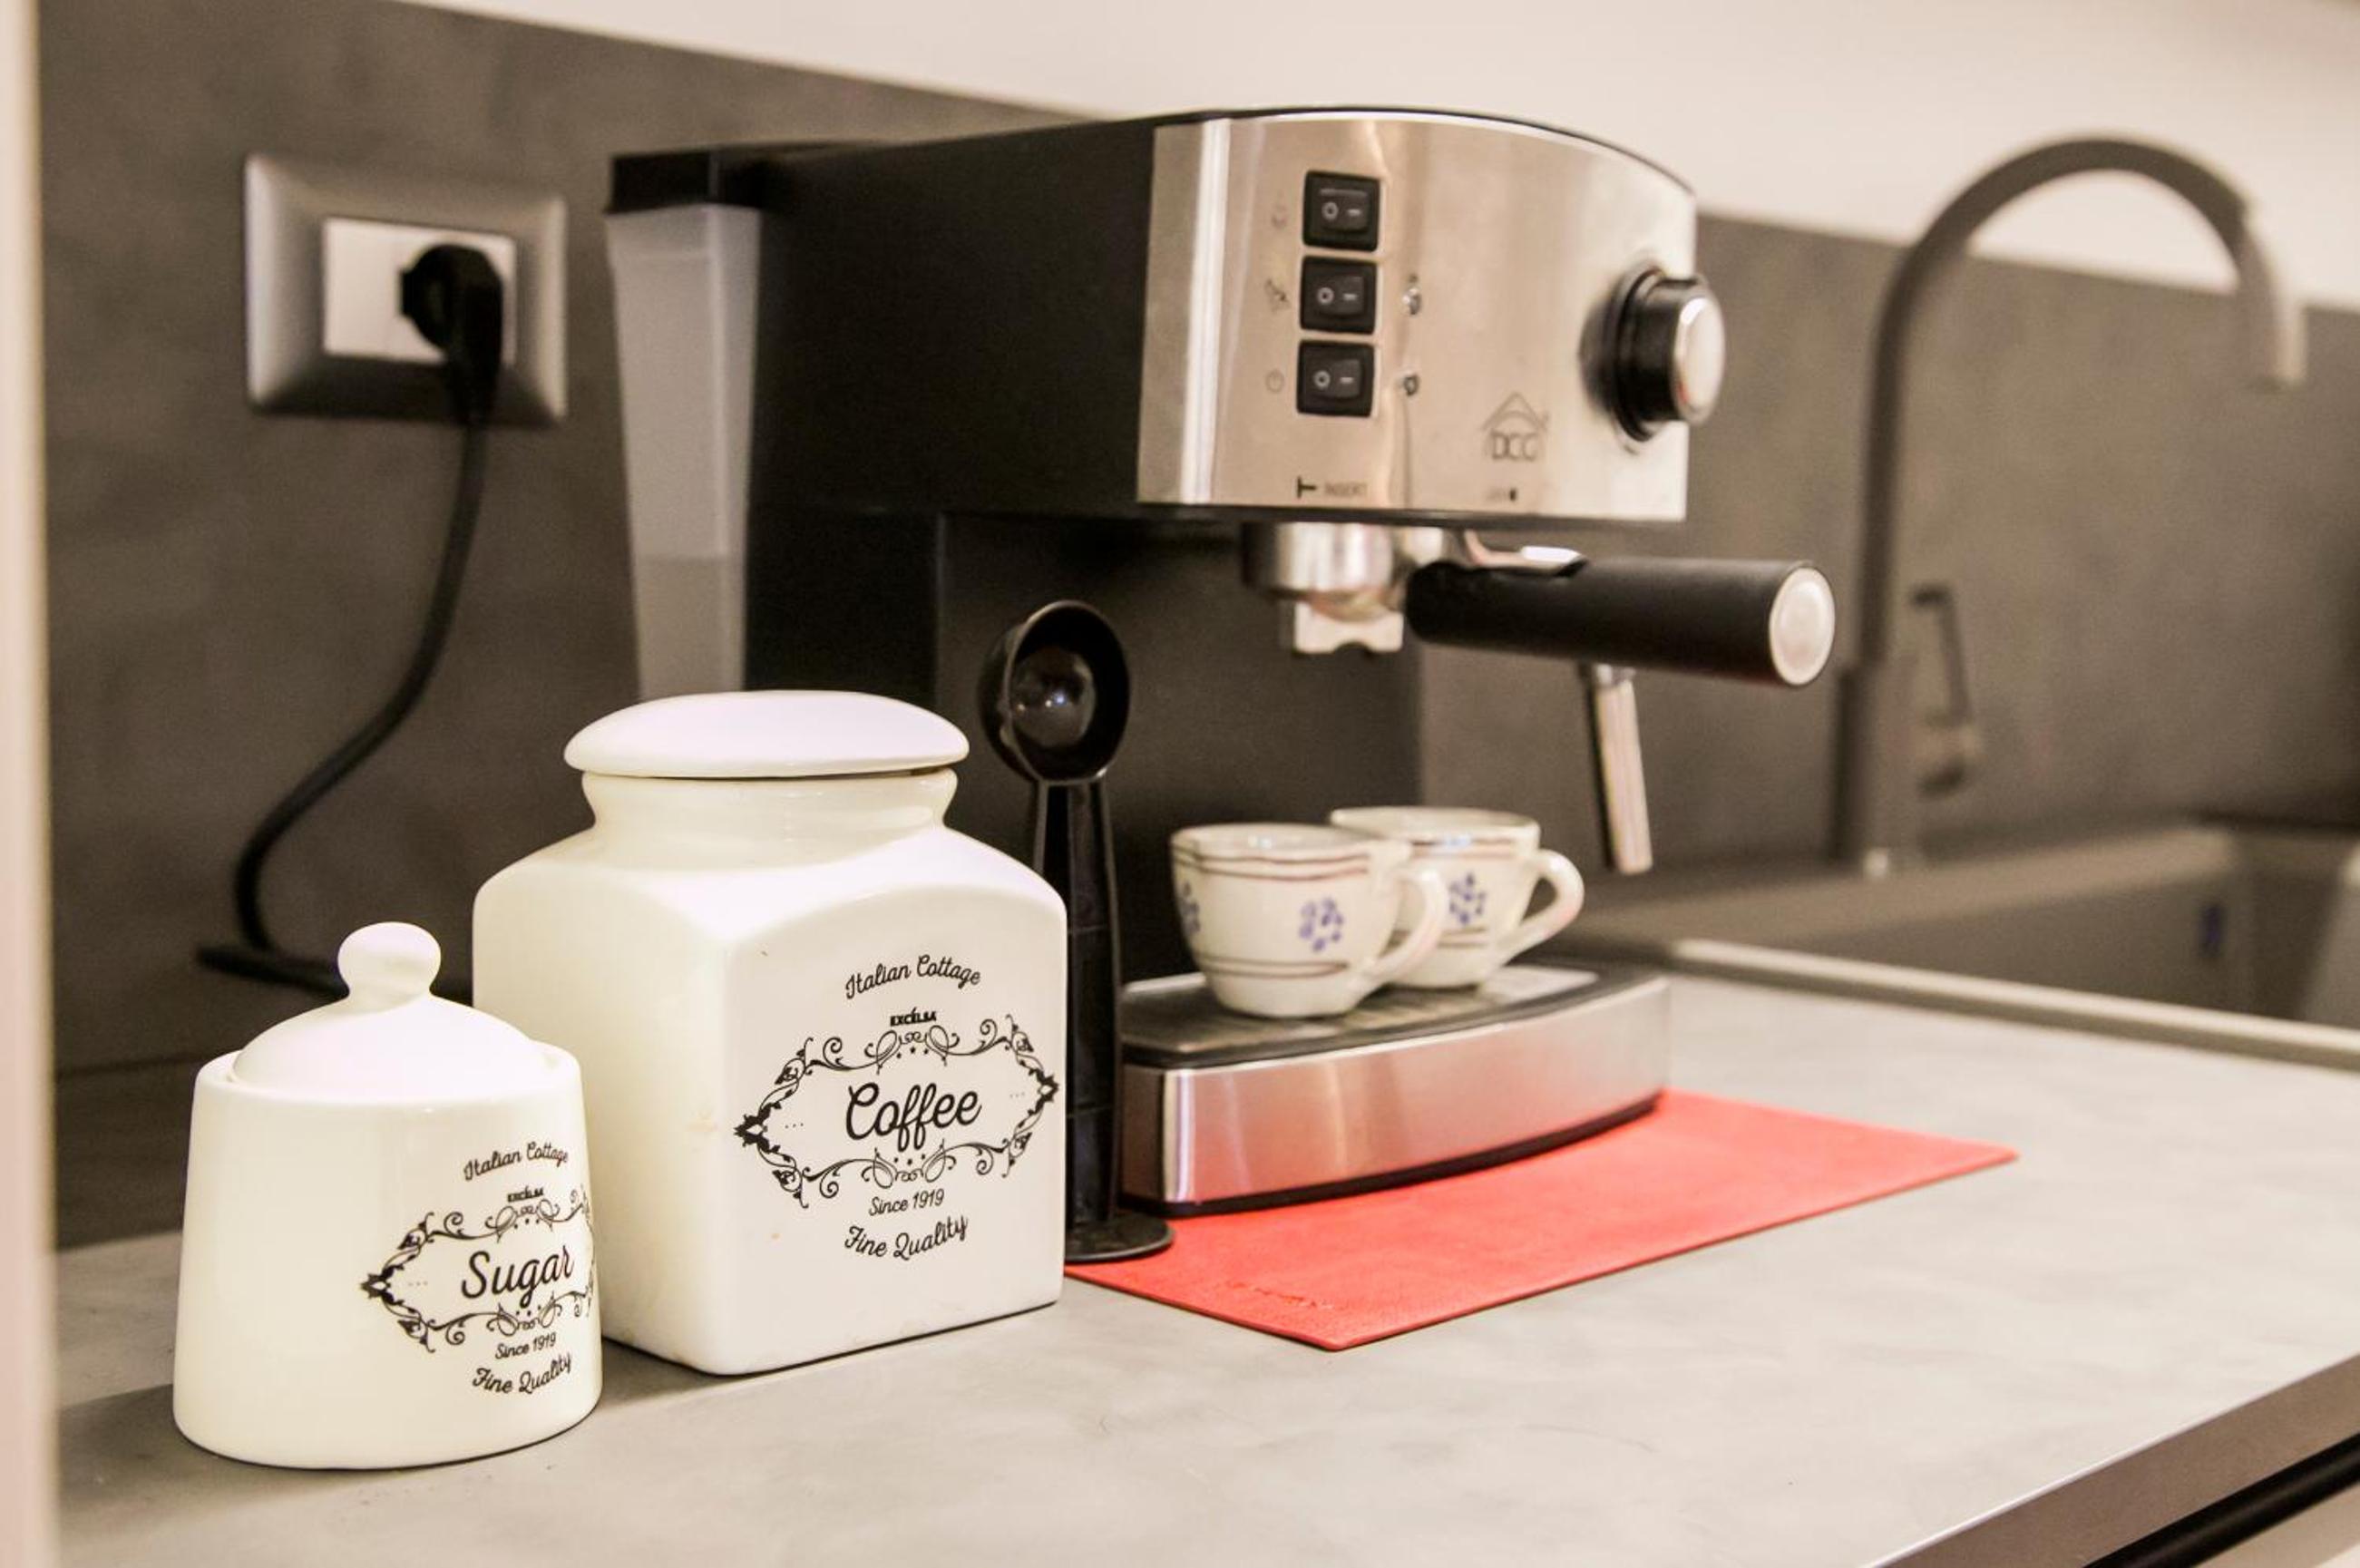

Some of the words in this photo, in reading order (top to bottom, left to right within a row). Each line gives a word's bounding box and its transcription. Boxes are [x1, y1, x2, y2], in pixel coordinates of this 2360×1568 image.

[844, 962, 912, 999] Italian
[916, 953, 981, 989] Cottage
[844, 1082, 982, 1153] Coffee
[463, 1150, 522, 1181] Italian
[526, 1140, 570, 1168] Cottage
[868, 1195, 909, 1216] Since
[912, 1187, 945, 1210] 1919
[844, 1224, 888, 1258] Fine
[892, 1214, 969, 1261] Quality
[460, 1244, 574, 1309] Sugar
[494, 1342, 530, 1359] Since
[532, 1332, 557, 1352] 1919
[472, 1367, 514, 1395] Fine
[519, 1352, 572, 1396] Quality
